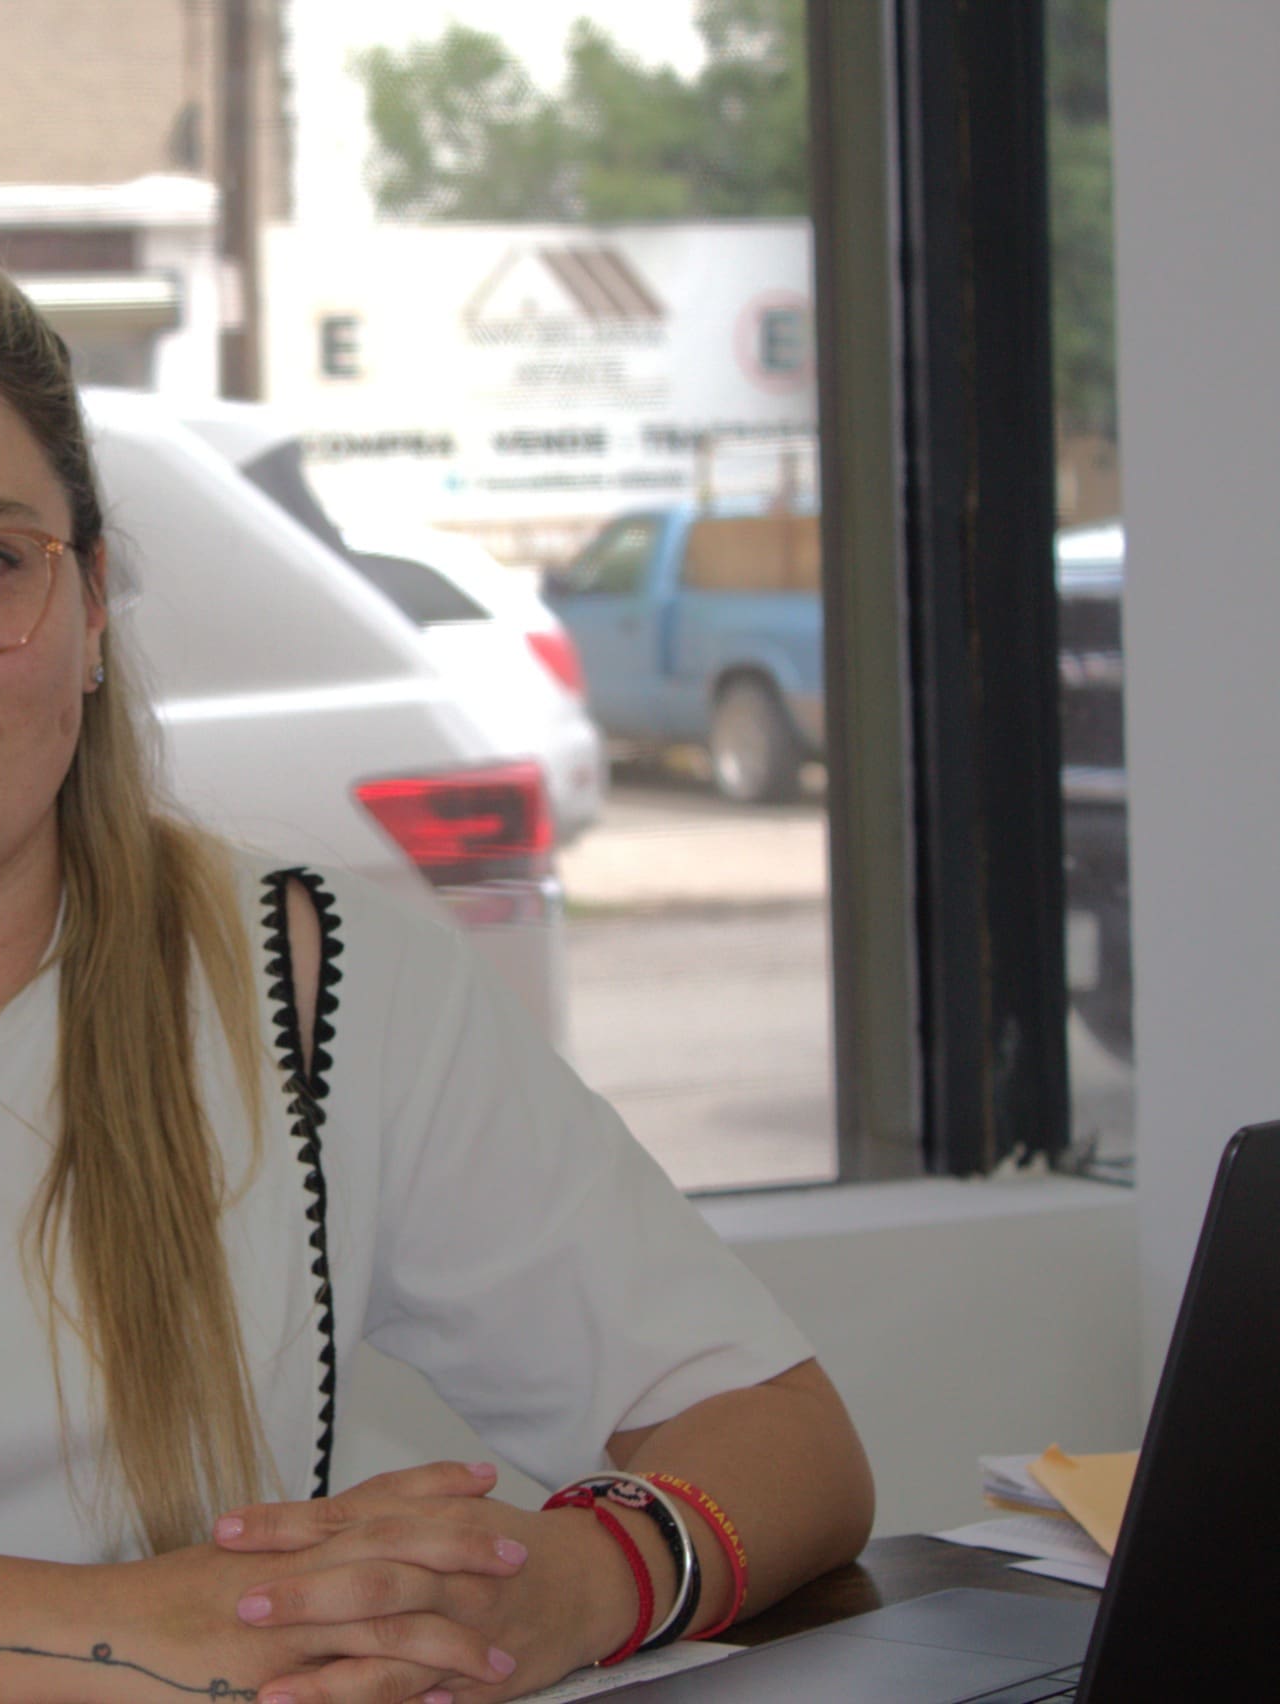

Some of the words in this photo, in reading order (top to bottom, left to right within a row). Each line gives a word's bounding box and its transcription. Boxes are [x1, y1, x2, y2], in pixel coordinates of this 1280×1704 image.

[320, 314, 360, 378] E
[659, 1474, 693, 1495] DEL
[699, 1491, 748, 1568] TRABAJO
